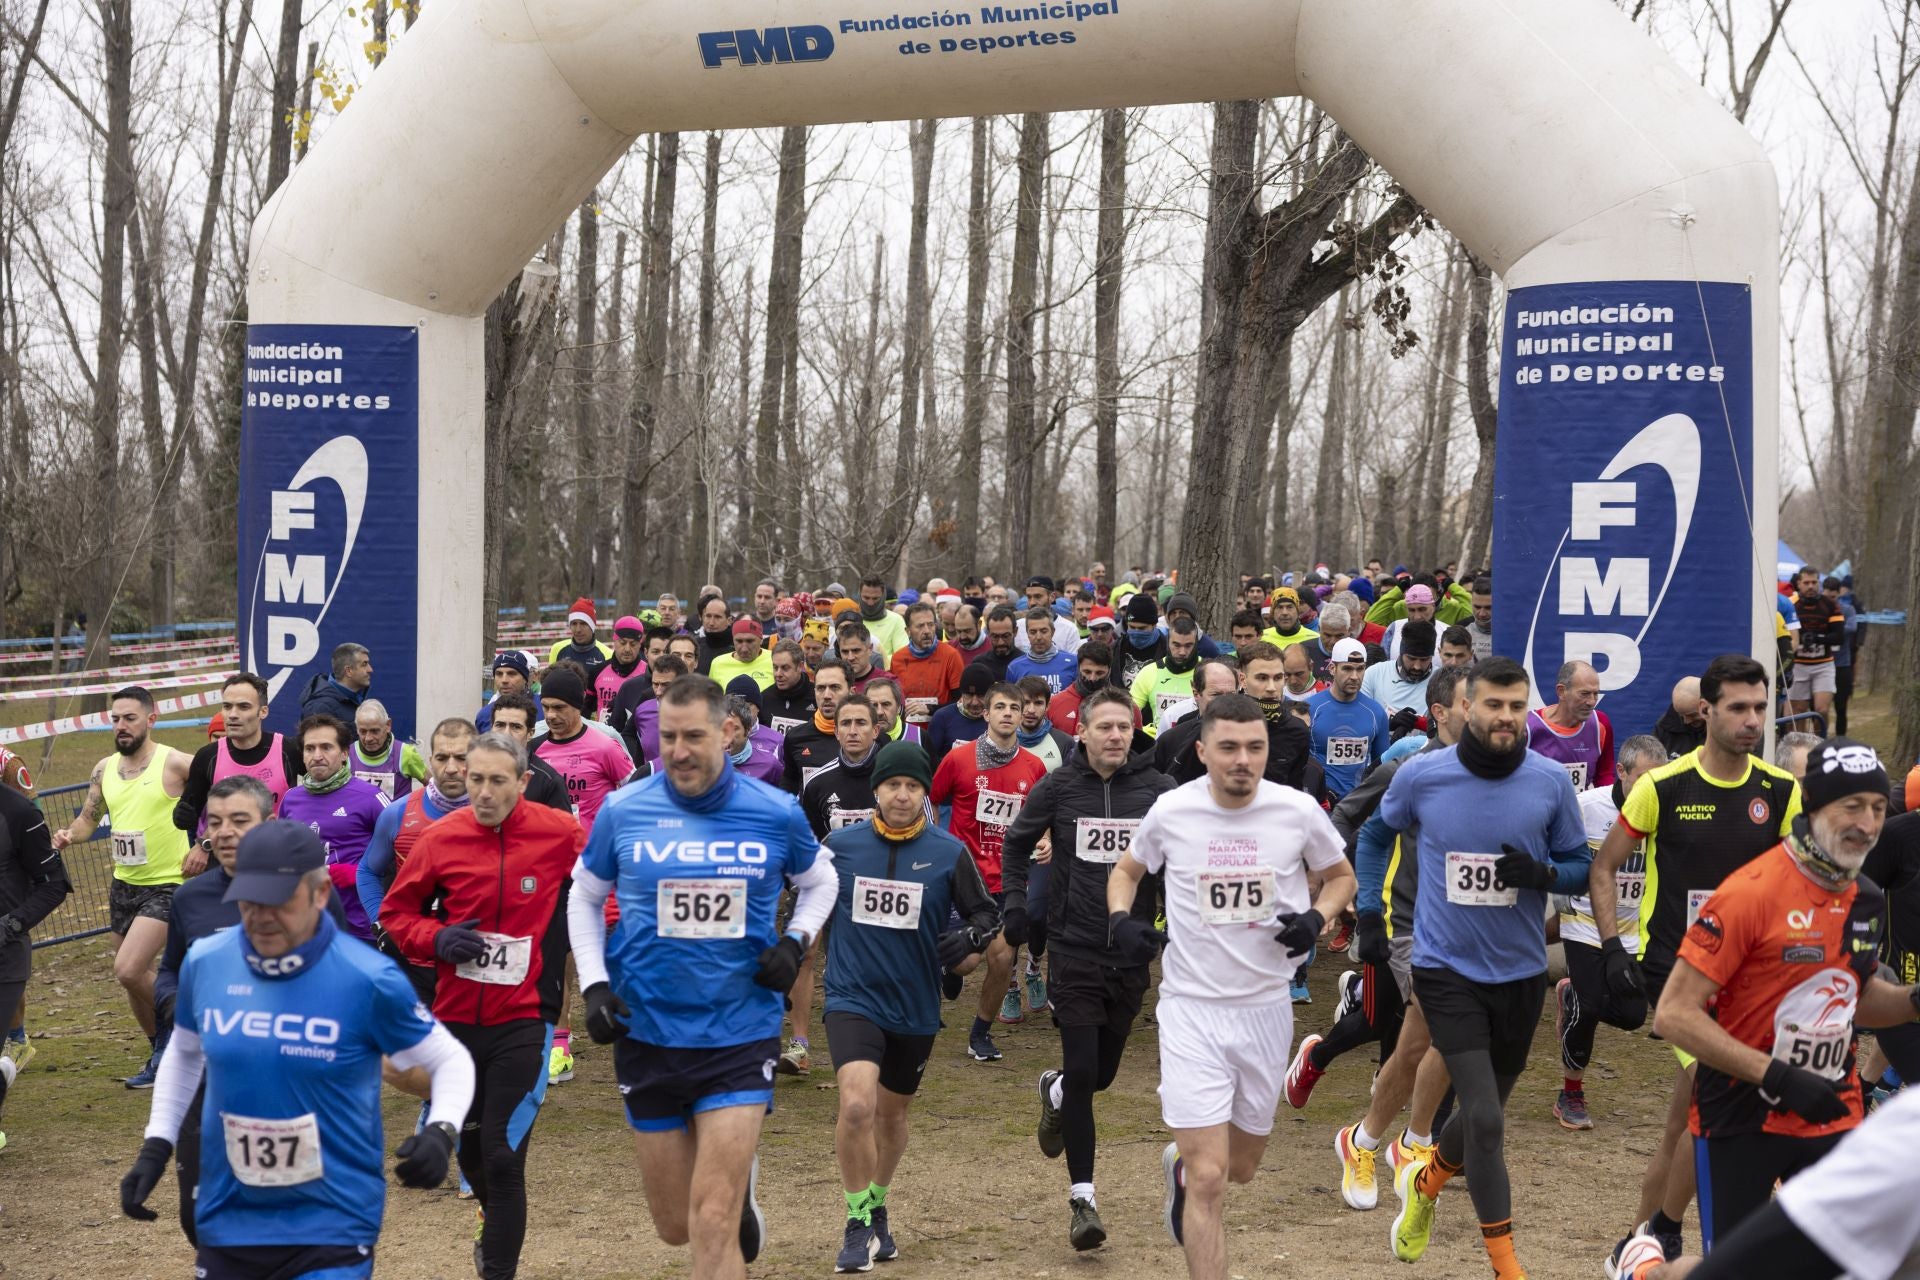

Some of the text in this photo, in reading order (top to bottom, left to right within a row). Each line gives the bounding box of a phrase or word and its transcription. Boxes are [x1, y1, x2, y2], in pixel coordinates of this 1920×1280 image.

[839, 0, 1119, 34] Fundación Municipal
[697, 25, 835, 69] FMD
[899, 29, 1077, 55] de Deportes
[1517, 303, 1674, 329] Fundación
[1516, 331, 1673, 356] Municipal
[1516, 362, 1725, 385] de Deportes
[260, 392, 390, 410] Deportes
[264, 491, 327, 667] FMD
[1334, 743, 1362, 758] 555
[984, 798, 1013, 818] 271
[1675, 804, 1716, 813] ATLÉTICO
[1679, 812, 1713, 821] PUCELA
[114, 838, 136, 857] 701
[1087, 829, 1131, 852] 285
[1208, 845, 1258, 853] MARATÓN
[632, 841, 768, 864] IVECO
[1208, 859, 1257, 867] POPULAR
[717, 865, 766, 879] running
[864, 889, 910, 917] 586
[1210, 881, 1263, 909] 675
[673, 893, 731, 922] 562
[203, 1008, 340, 1044] IVECO
[280, 1044, 337, 1062] running
[1789, 1038, 1845, 1071] 500
[237, 1134, 300, 1169] 137
